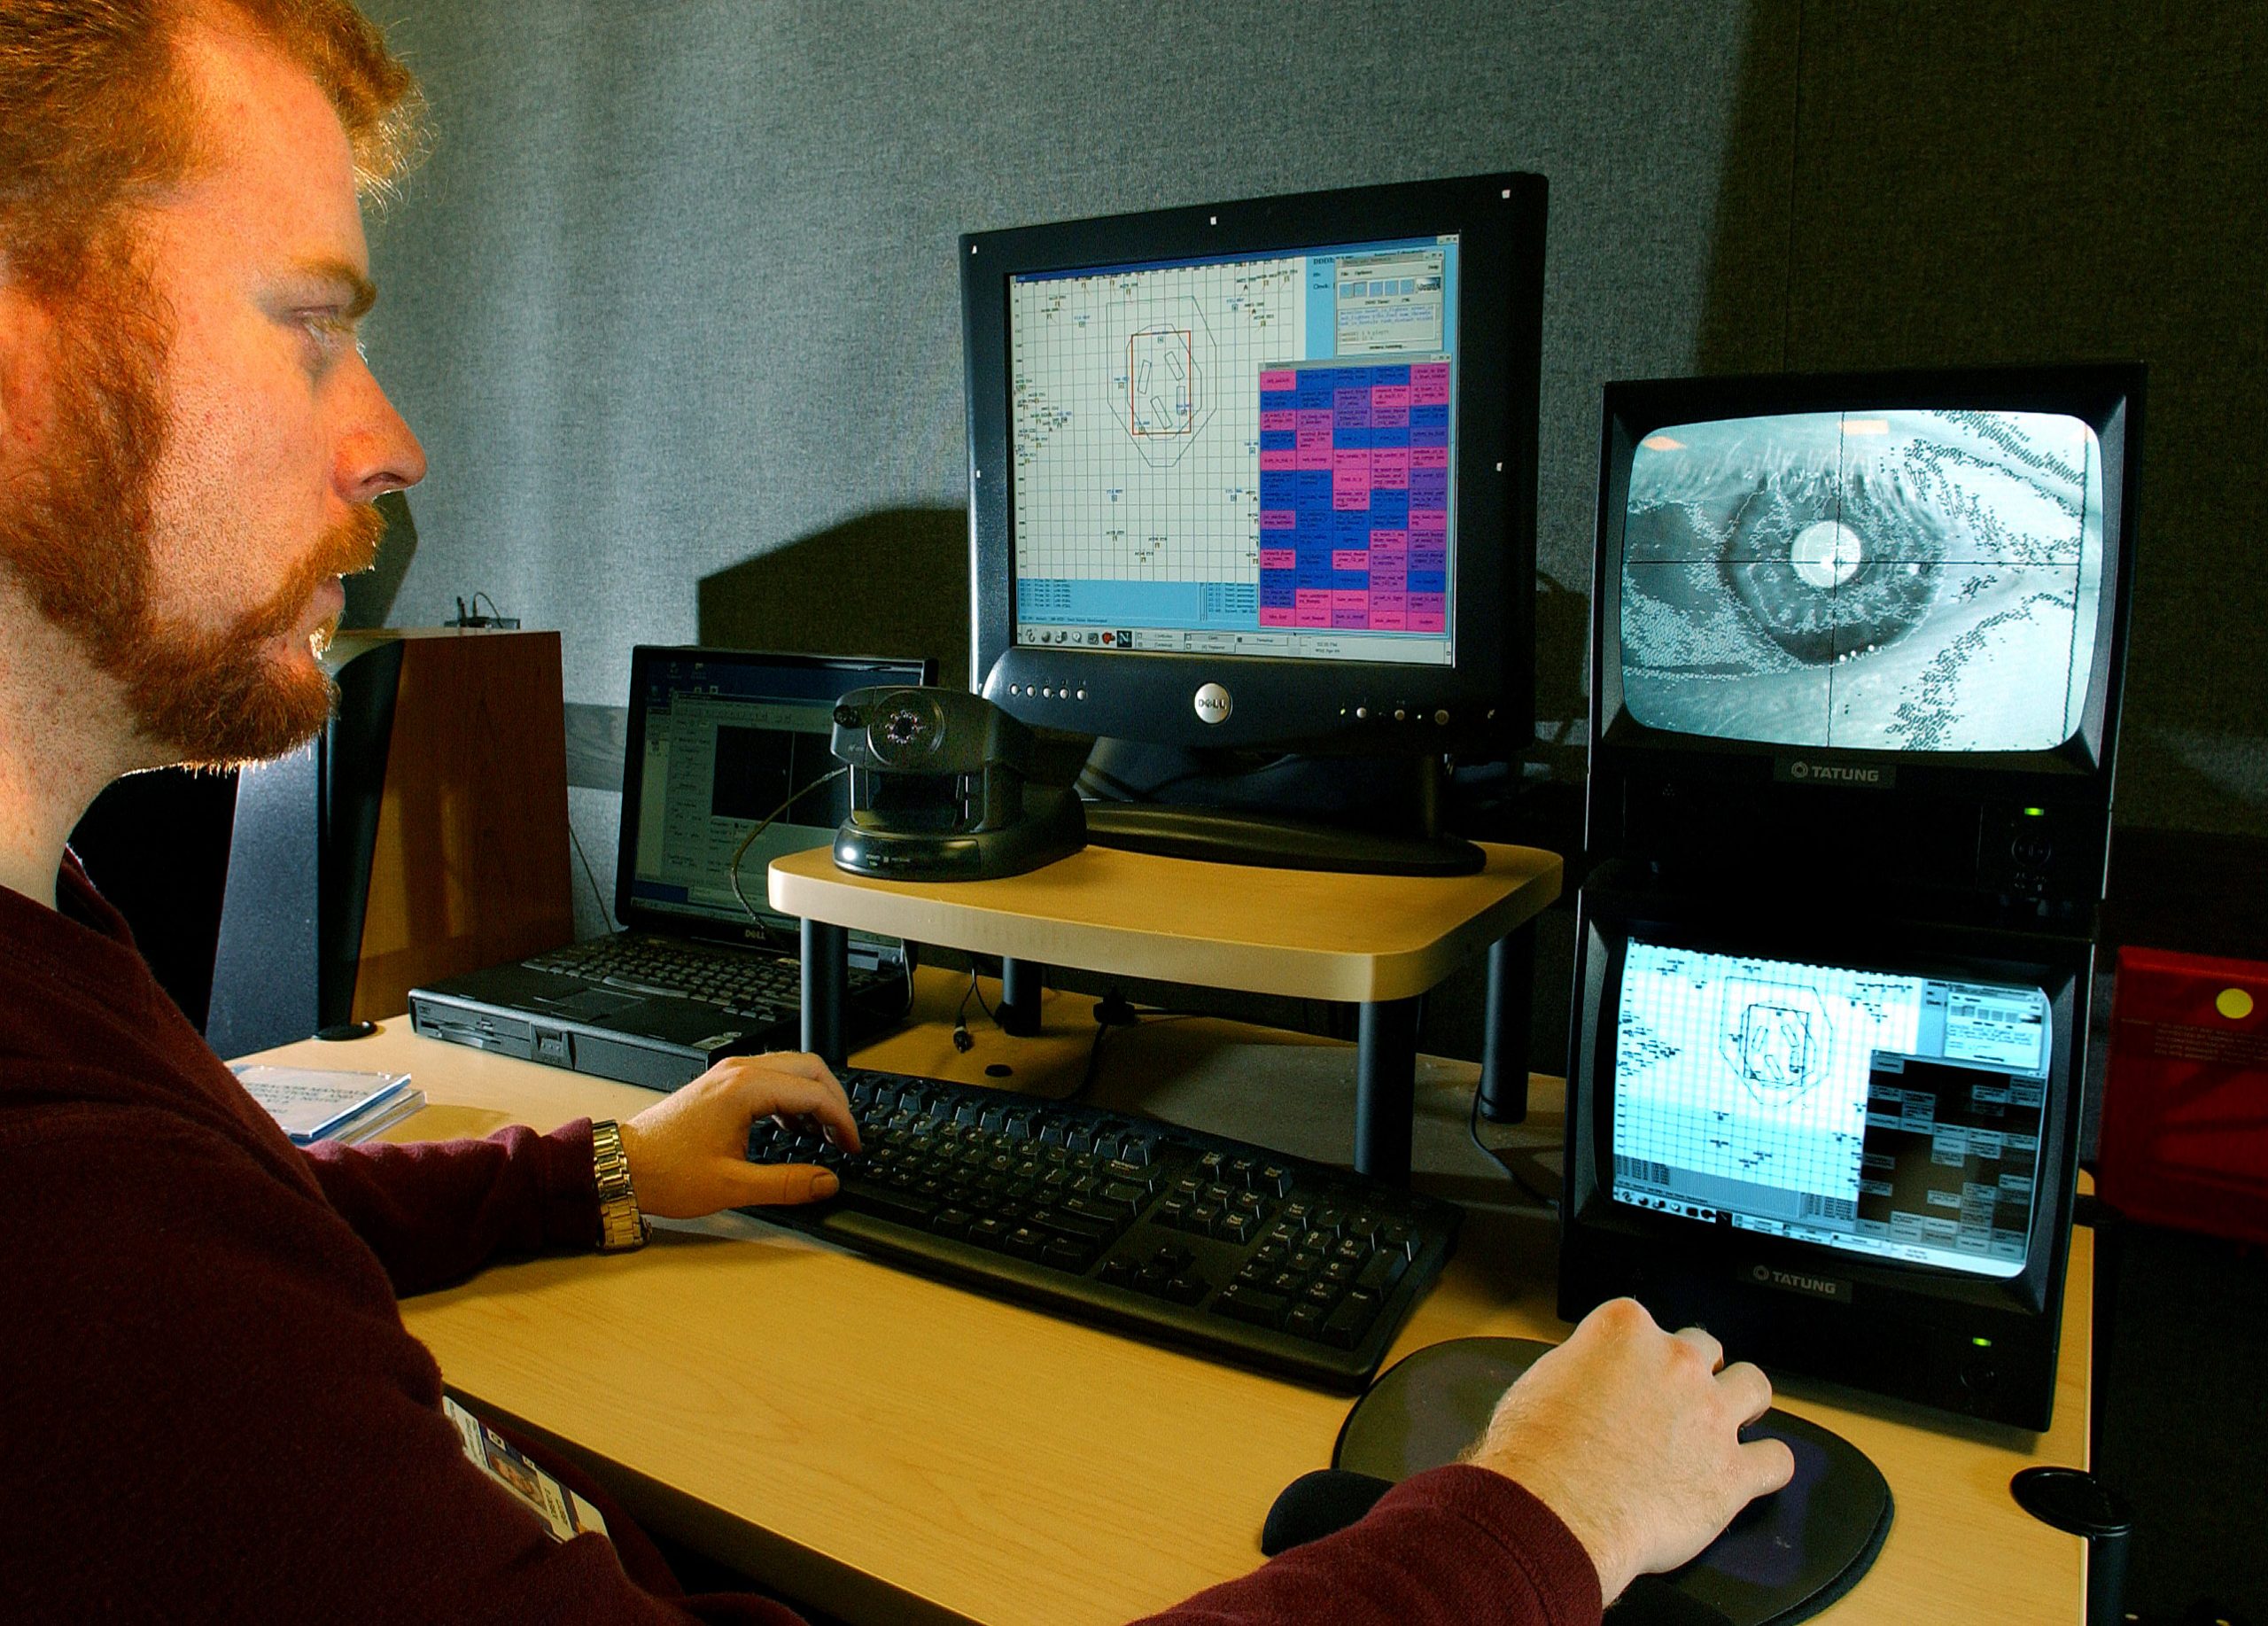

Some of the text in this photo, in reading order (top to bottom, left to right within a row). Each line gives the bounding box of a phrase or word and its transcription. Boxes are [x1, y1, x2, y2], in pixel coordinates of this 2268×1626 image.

[1198, 697, 1227, 710] DELL
[1811, 765, 1879, 782] TATUNG
[1772, 1270, 1837, 1295] TATUNG
